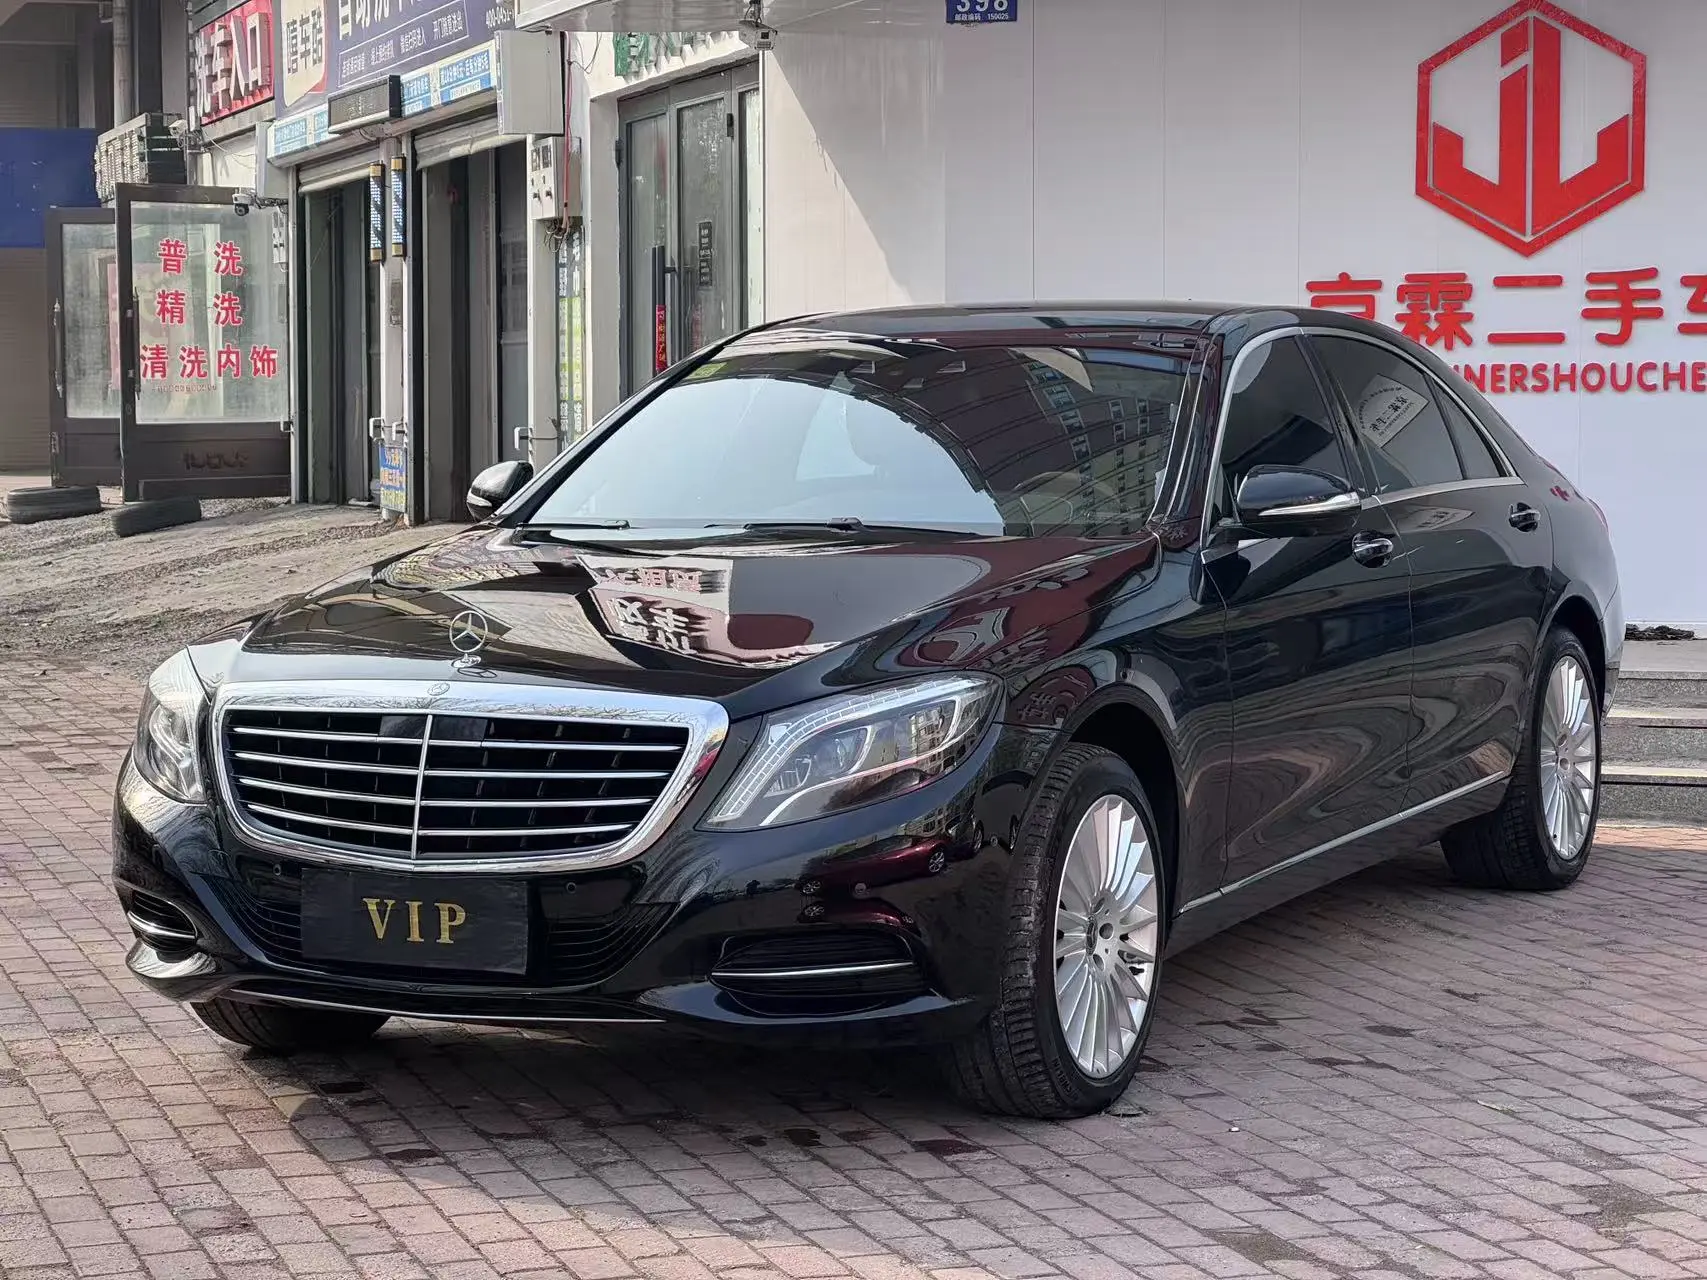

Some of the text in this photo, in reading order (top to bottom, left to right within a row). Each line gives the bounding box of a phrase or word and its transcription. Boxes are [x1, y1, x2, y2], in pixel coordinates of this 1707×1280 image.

[956, 0, 1008, 12] 398
[195, 11, 269, 118] 洗车入口
[140, 344, 278, 379] 清洗内饰
[1453, 361, 1707, 394] NERSHOUCHE
[362, 898, 467, 944] VIP
